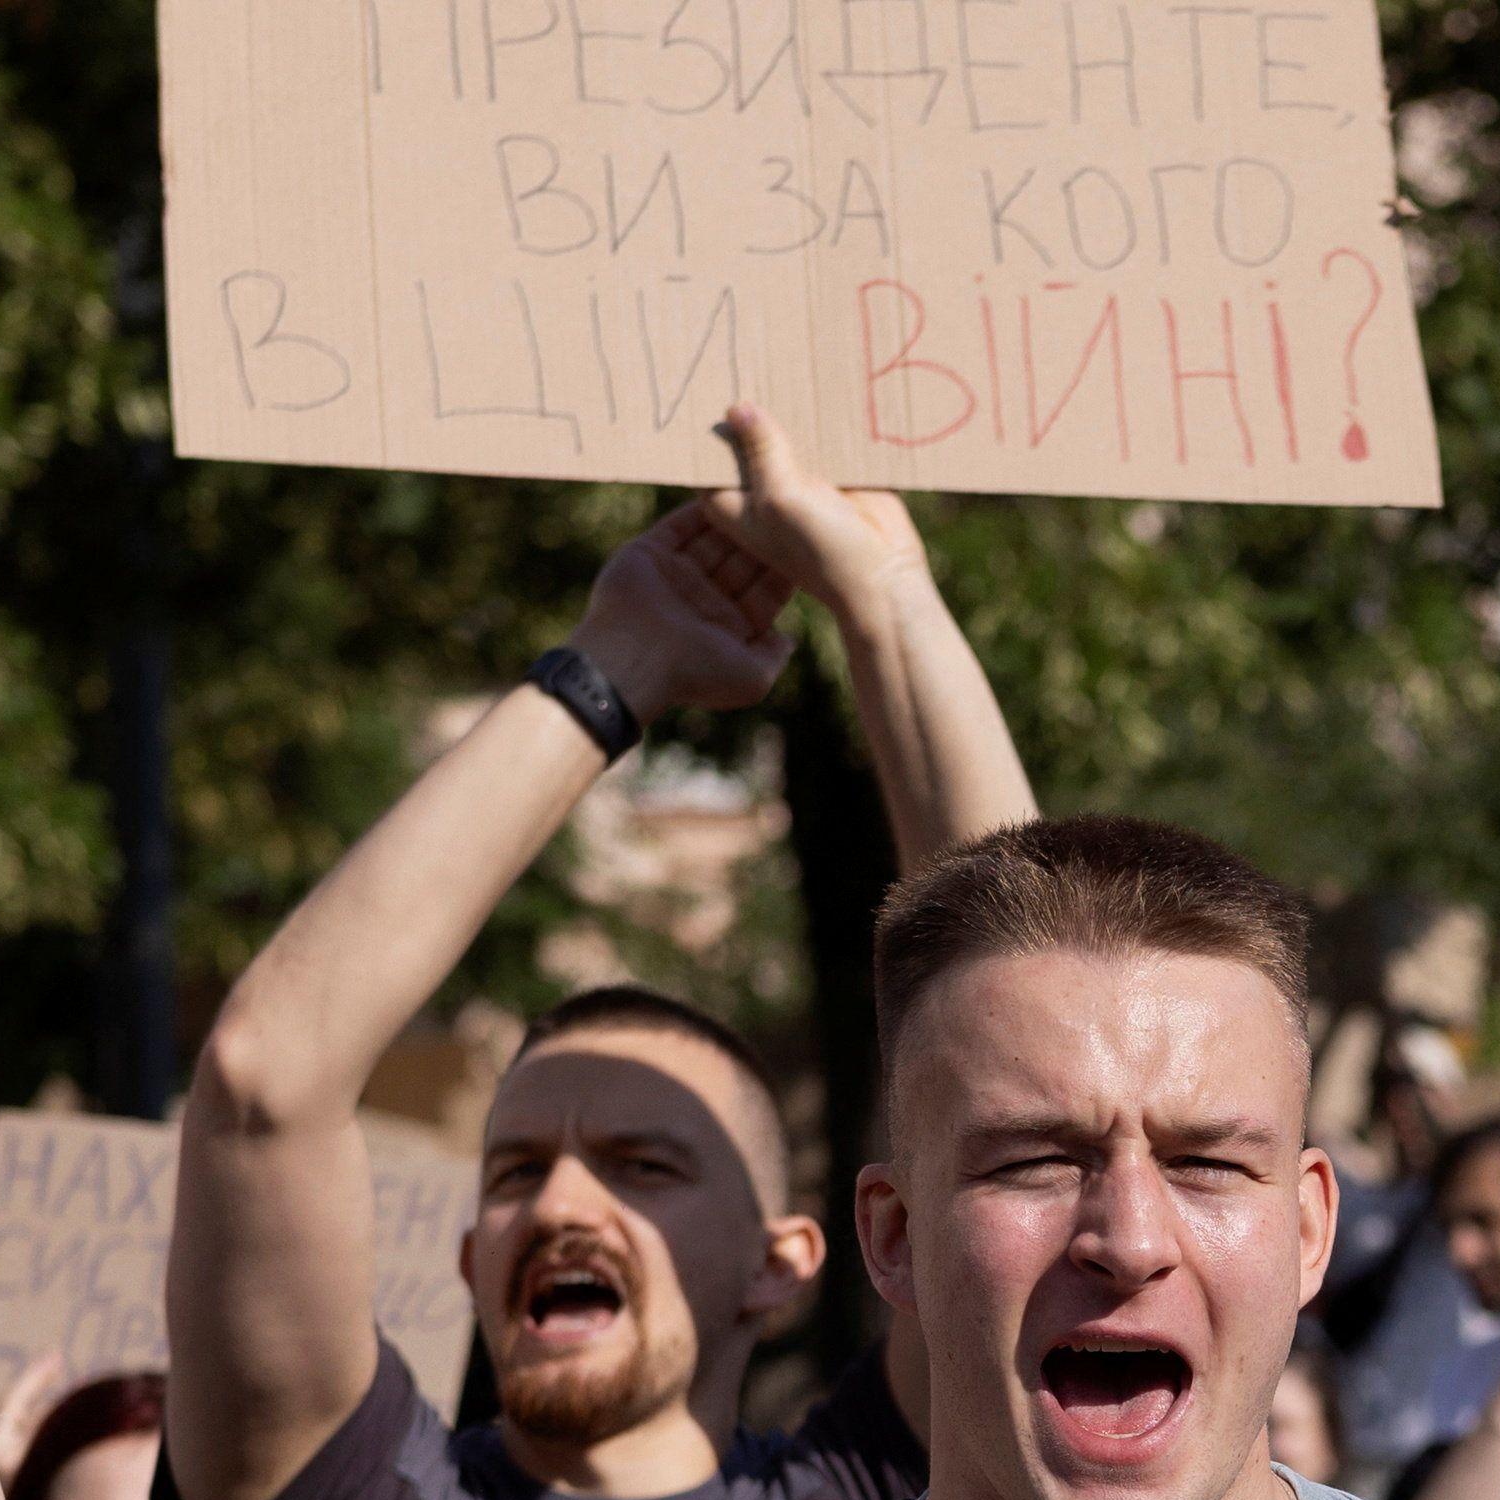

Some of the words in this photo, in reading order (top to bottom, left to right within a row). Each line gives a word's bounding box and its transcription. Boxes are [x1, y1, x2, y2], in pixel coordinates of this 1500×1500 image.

[498, 133, 686, 257] ВИ
[745, 157, 890, 257] ЗА
[981, 158, 1296, 270] КОГО
[220, 269, 352, 411] В
[417, 274, 742, 454] ЦІЙ
[859, 247, 1383, 467] ВІЙНІ?
